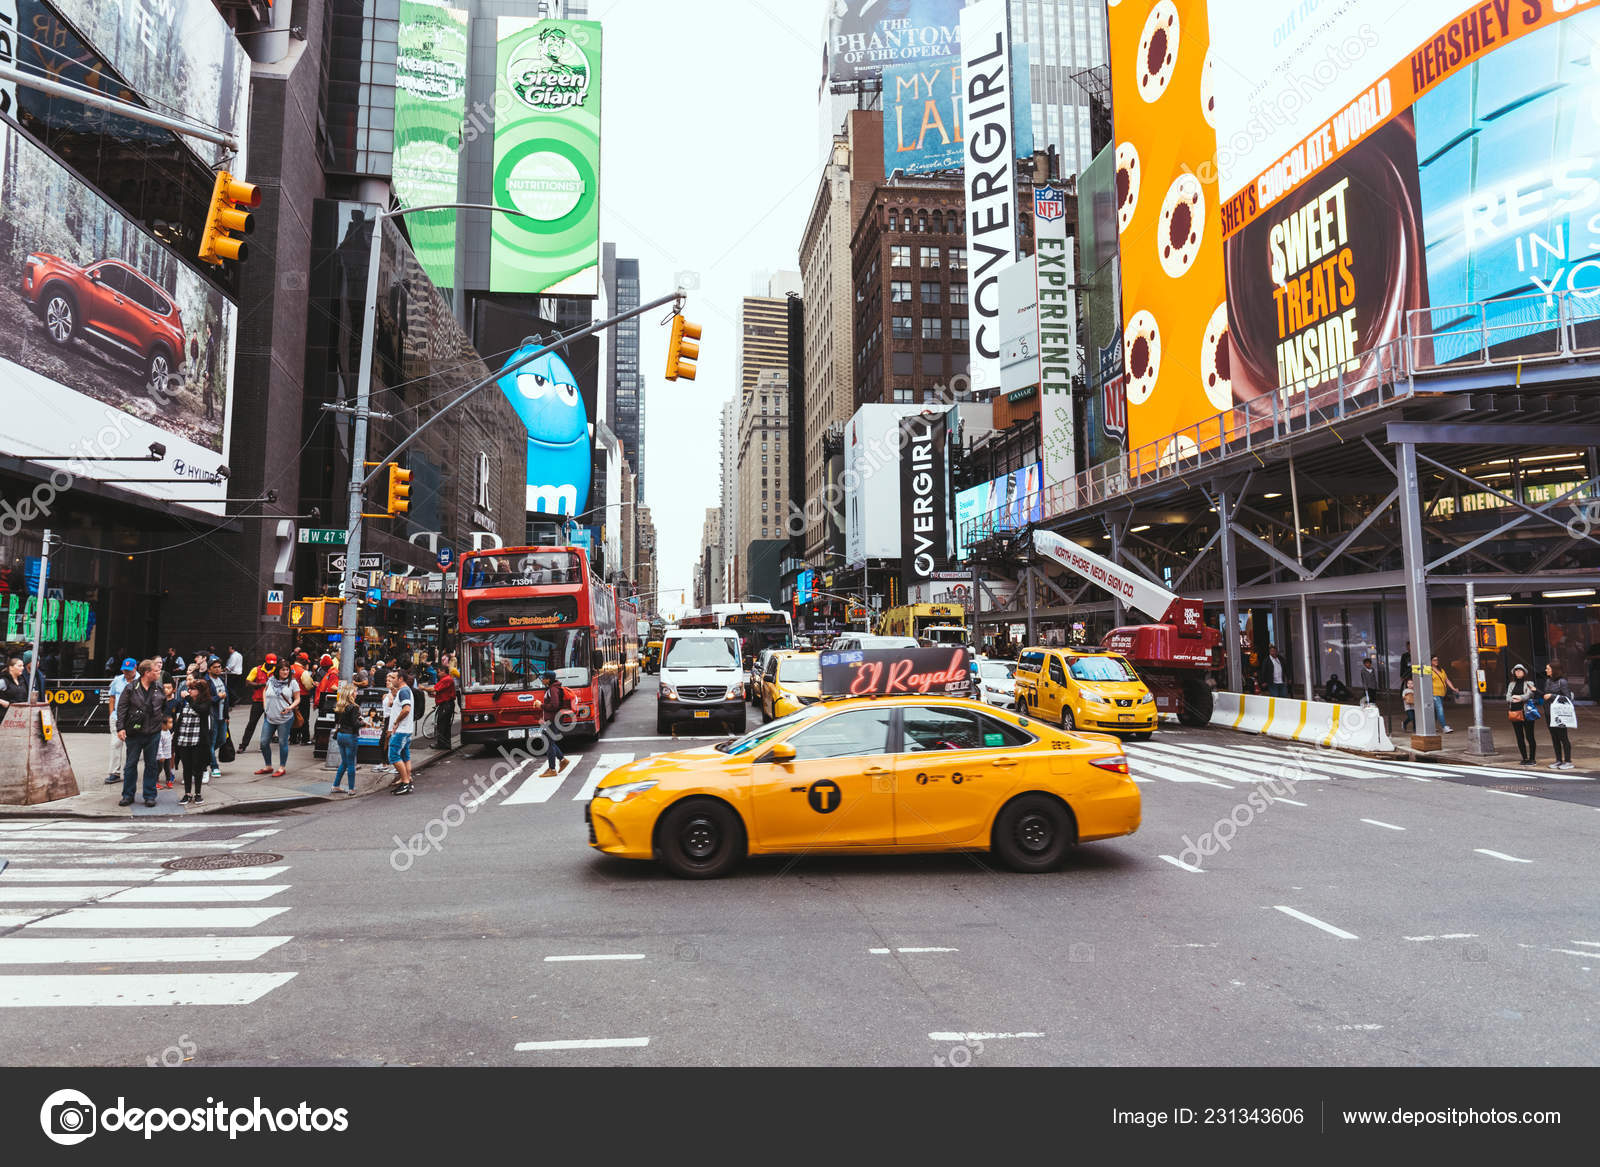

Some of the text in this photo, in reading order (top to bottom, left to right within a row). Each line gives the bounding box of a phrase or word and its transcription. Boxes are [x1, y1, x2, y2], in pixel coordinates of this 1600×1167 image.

[834, 25, 960, 54] PHANTOM
[880, 18, 912, 31] THE
[518, 66, 586, 87] Green
[844, 44, 951, 63] OF THE OPERA
[524, 86, 588, 106] Giant
[896, 69, 941, 102] MY
[1257, 77, 1393, 209] CHOCOLATE WORLD
[508, 180, 582, 193] NUTRITIONIST
[967, 32, 1010, 360] COVERGIRL
[1037, 201, 1062, 218] NFL
[1269, 177, 1349, 285] SWEET
[1515, 224, 1566, 272] IN
[1273, 247, 1356, 340] TREATS
[1530, 260, 1600, 307] YO
[1037, 238, 1071, 396] EXPERIENCE
[1276, 307, 1362, 401] INSIDE
[1010, 387, 1032, 401] LAMAR
[1104, 375, 1125, 428] NF
[311, 531, 320, 541] W
[324, 532, 335, 542] 47
[1054, 545, 1071, 562] NORTH
[1071, 553, 1090, 573] SHORE
[1090, 564, 1108, 583] NEON
[1107, 574, 1123, 592] SIGN
[850, 648, 967, 695] El Royale
